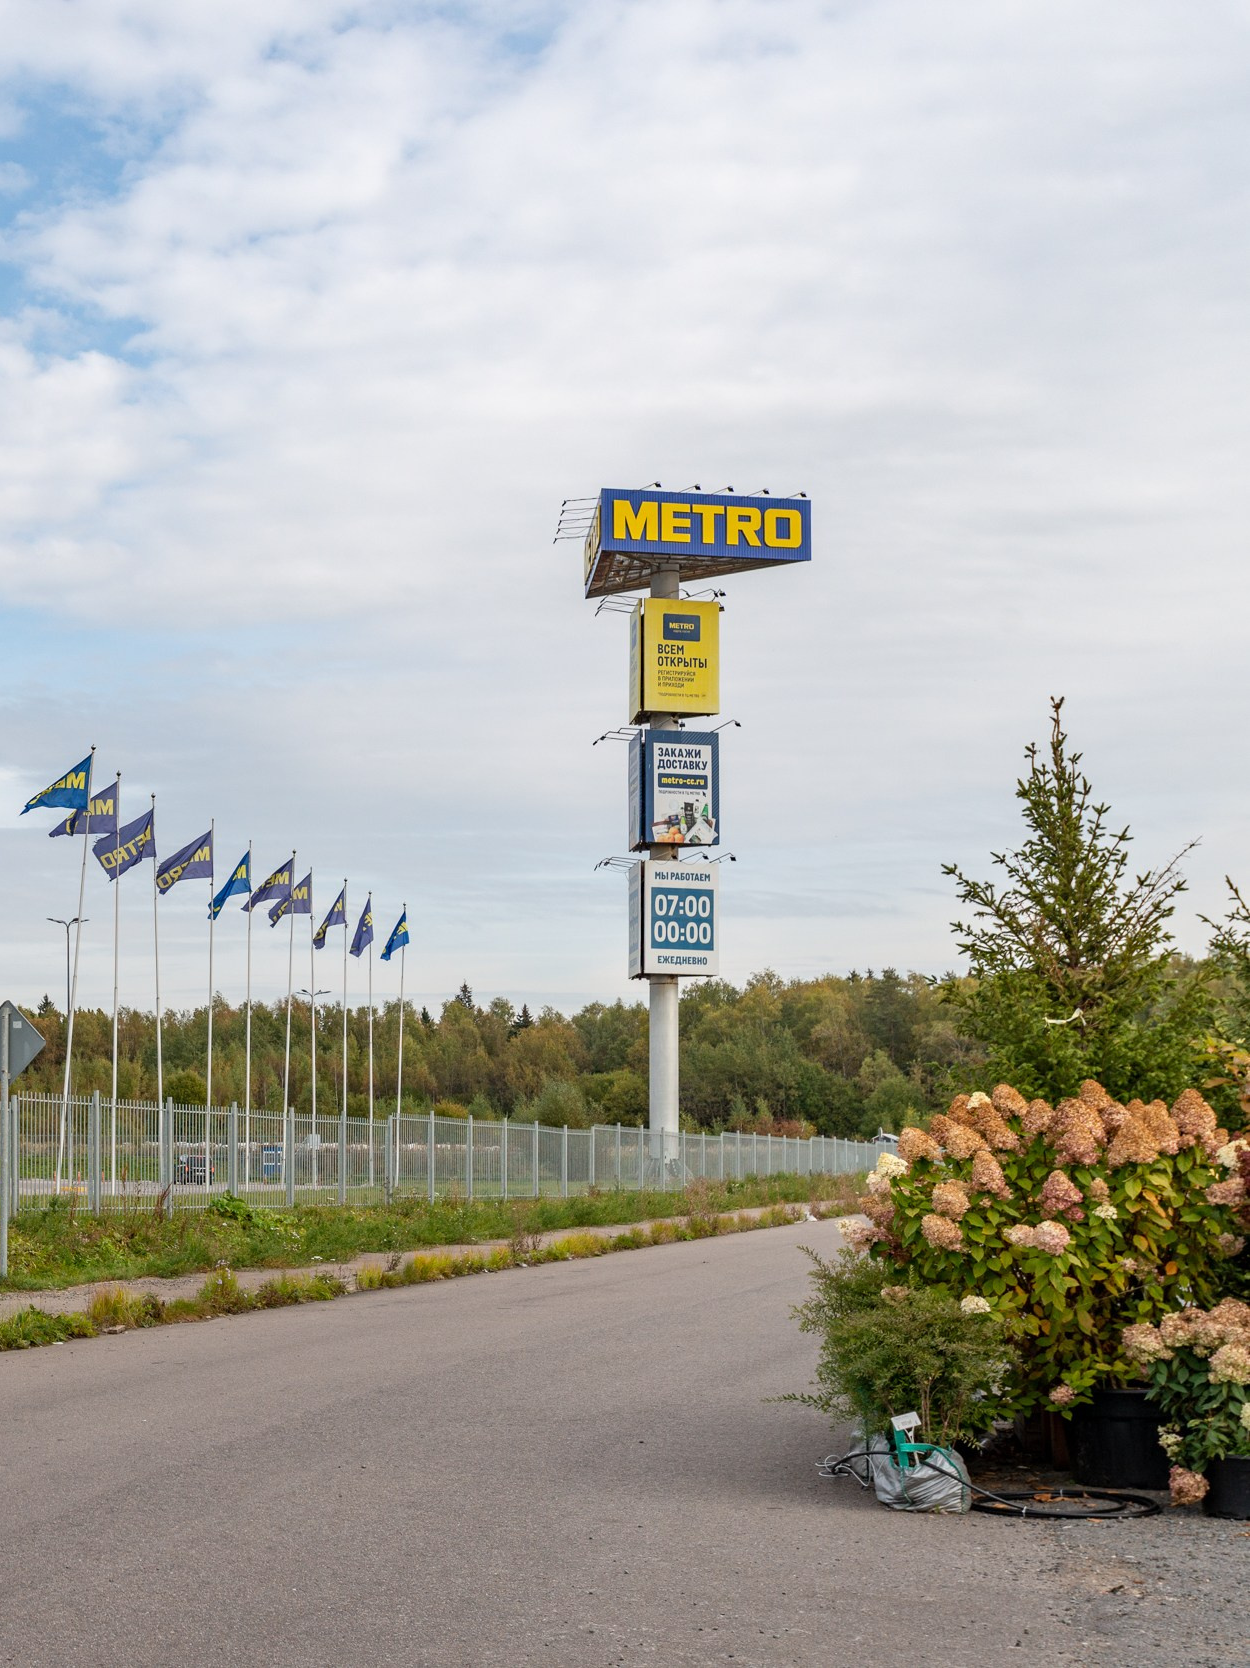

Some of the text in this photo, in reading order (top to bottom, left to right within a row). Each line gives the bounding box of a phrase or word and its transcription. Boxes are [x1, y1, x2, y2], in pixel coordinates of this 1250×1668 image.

[613, 499, 802, 548] METRO
[669, 622, 695, 630] METRO
[657, 643, 685, 655] ВСЕМ
[657, 656, 708, 669] ОТКРЫТЫ
[657, 747, 702, 759] ЗАКАЖИ
[657, 759, 708, 771] ДОСТАВКУ
[661, 776, 705, 786] metro-cc.ru
[654, 871, 711, 882] МЫ РАБОТАЕМ
[654, 894, 711, 918] 07:00
[654, 920, 711, 944] 00:00
[657, 955, 708, 966] ЕЖЕДНЕВНО
